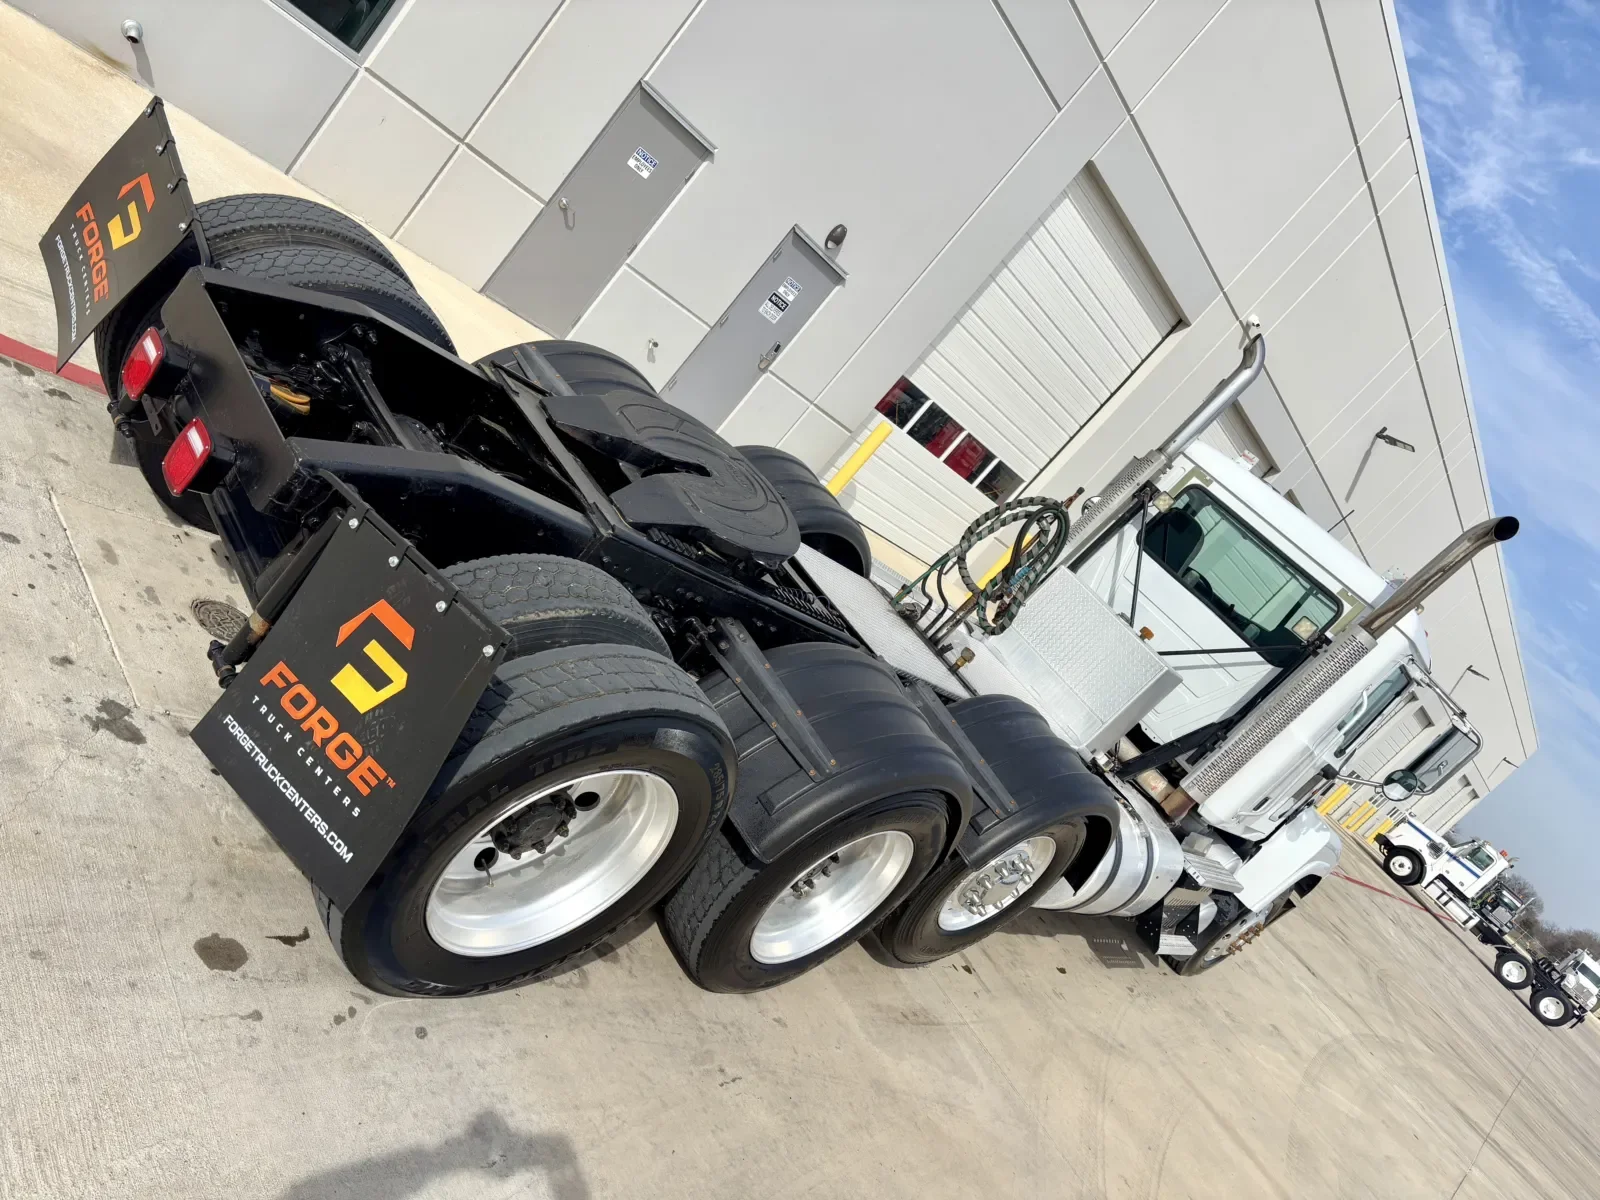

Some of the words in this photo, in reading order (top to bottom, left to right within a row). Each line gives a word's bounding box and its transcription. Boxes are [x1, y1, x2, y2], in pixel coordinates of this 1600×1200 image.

[632, 154, 652, 173] EMPLOYEES
[634, 163, 644, 173] ONLY
[637, 148, 657, 168] NOTICE
[55, 234, 77, 343] FORGETRUCKCENTERS.COM
[69, 223, 84, 263] TRUCK
[81, 267, 91, 315] CENTERS
[75, 201, 109, 303] FORGE
[770, 294, 787, 310] NOTICE
[252, 695, 293, 742] TRUCK
[297, 747, 360, 817] CENTERS
[259, 661, 387, 796] FORGE
[223, 714, 354, 863] FORGETRUCKCENTERS.COM
